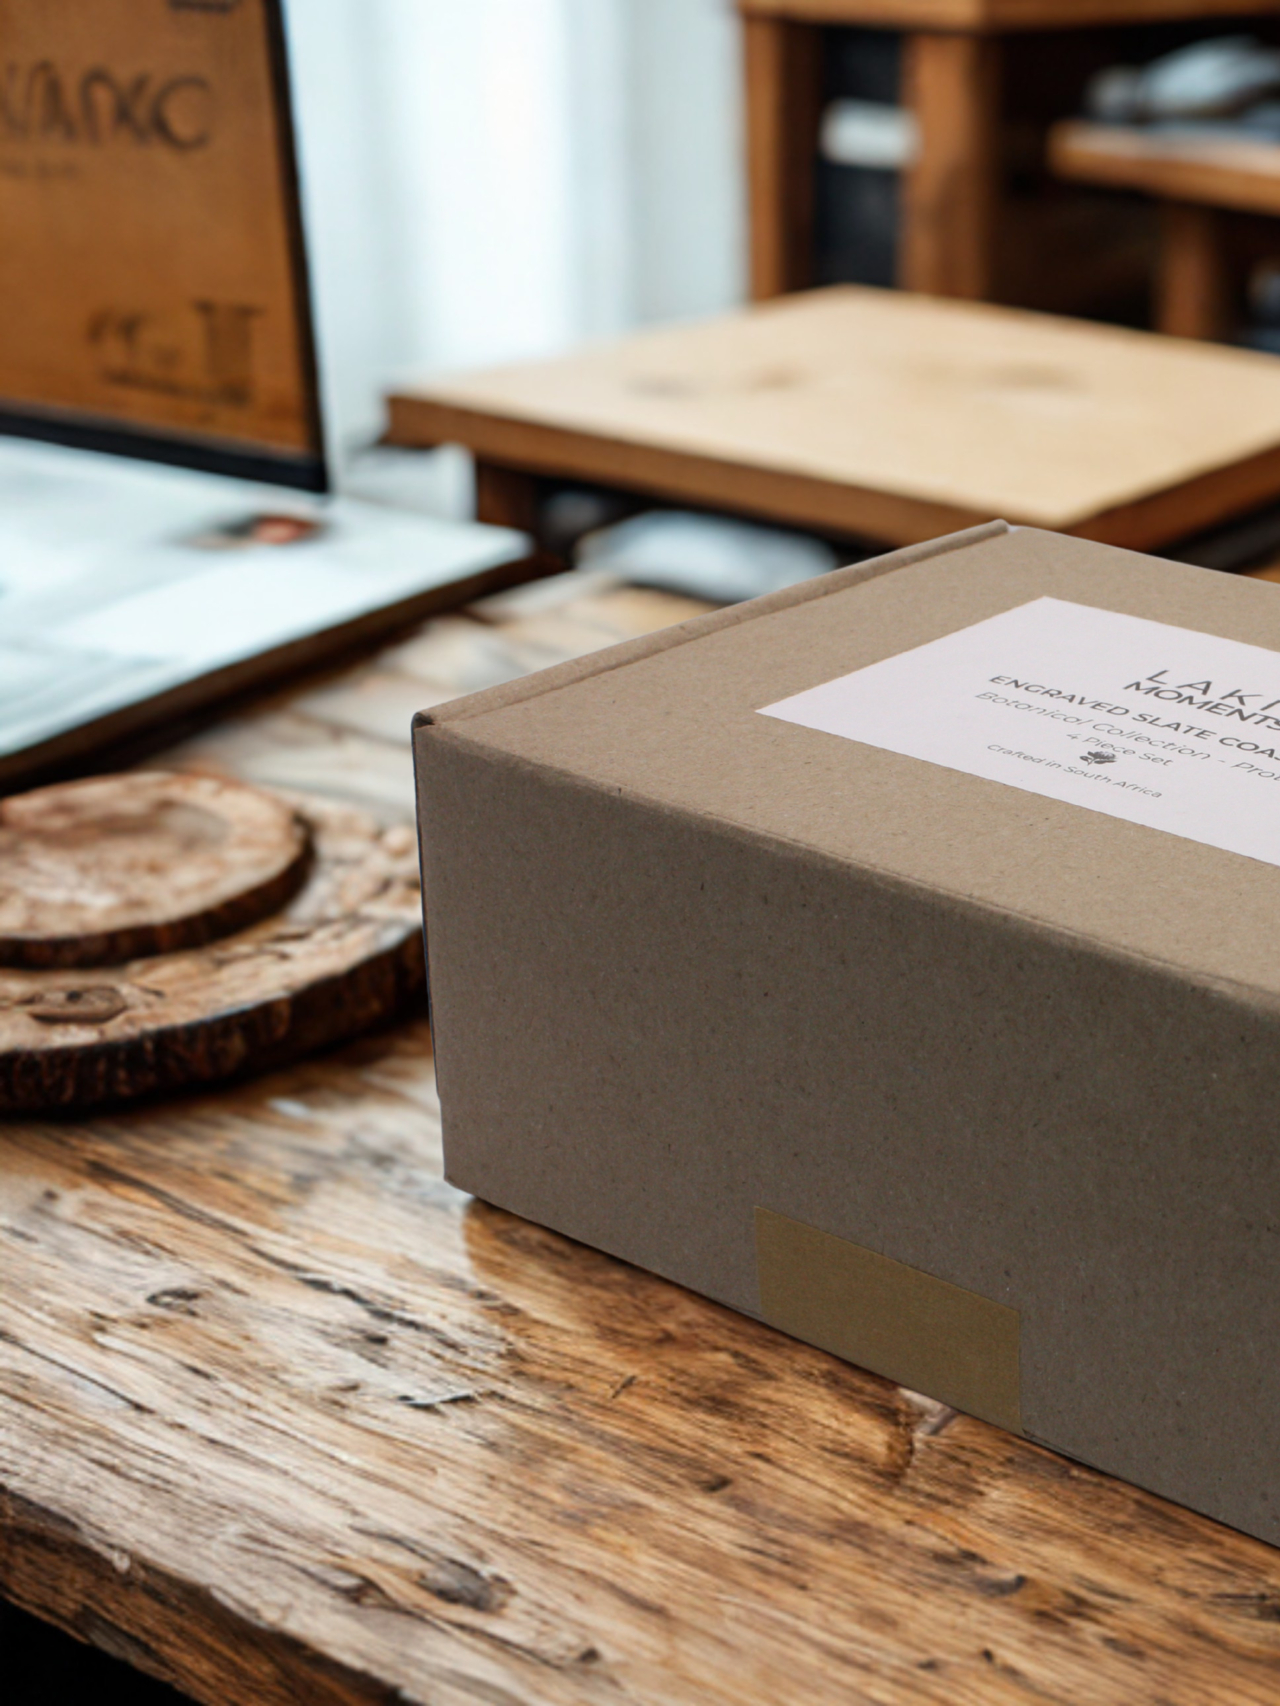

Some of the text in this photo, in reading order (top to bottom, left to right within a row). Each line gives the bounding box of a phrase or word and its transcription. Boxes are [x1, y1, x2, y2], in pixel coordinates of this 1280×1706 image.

[975, 691, 1093, 725] Botanical
[1092, 723, 1211, 760] Collection
[989, 675, 1130, 716] ENGRAVED
[1132, 712, 1217, 740] SLATE
[987, 744, 1163, 798] Crafted in South Africa
[1082, 736, 1136, 755] Piece
[1139, 752, 1173, 767] Set
